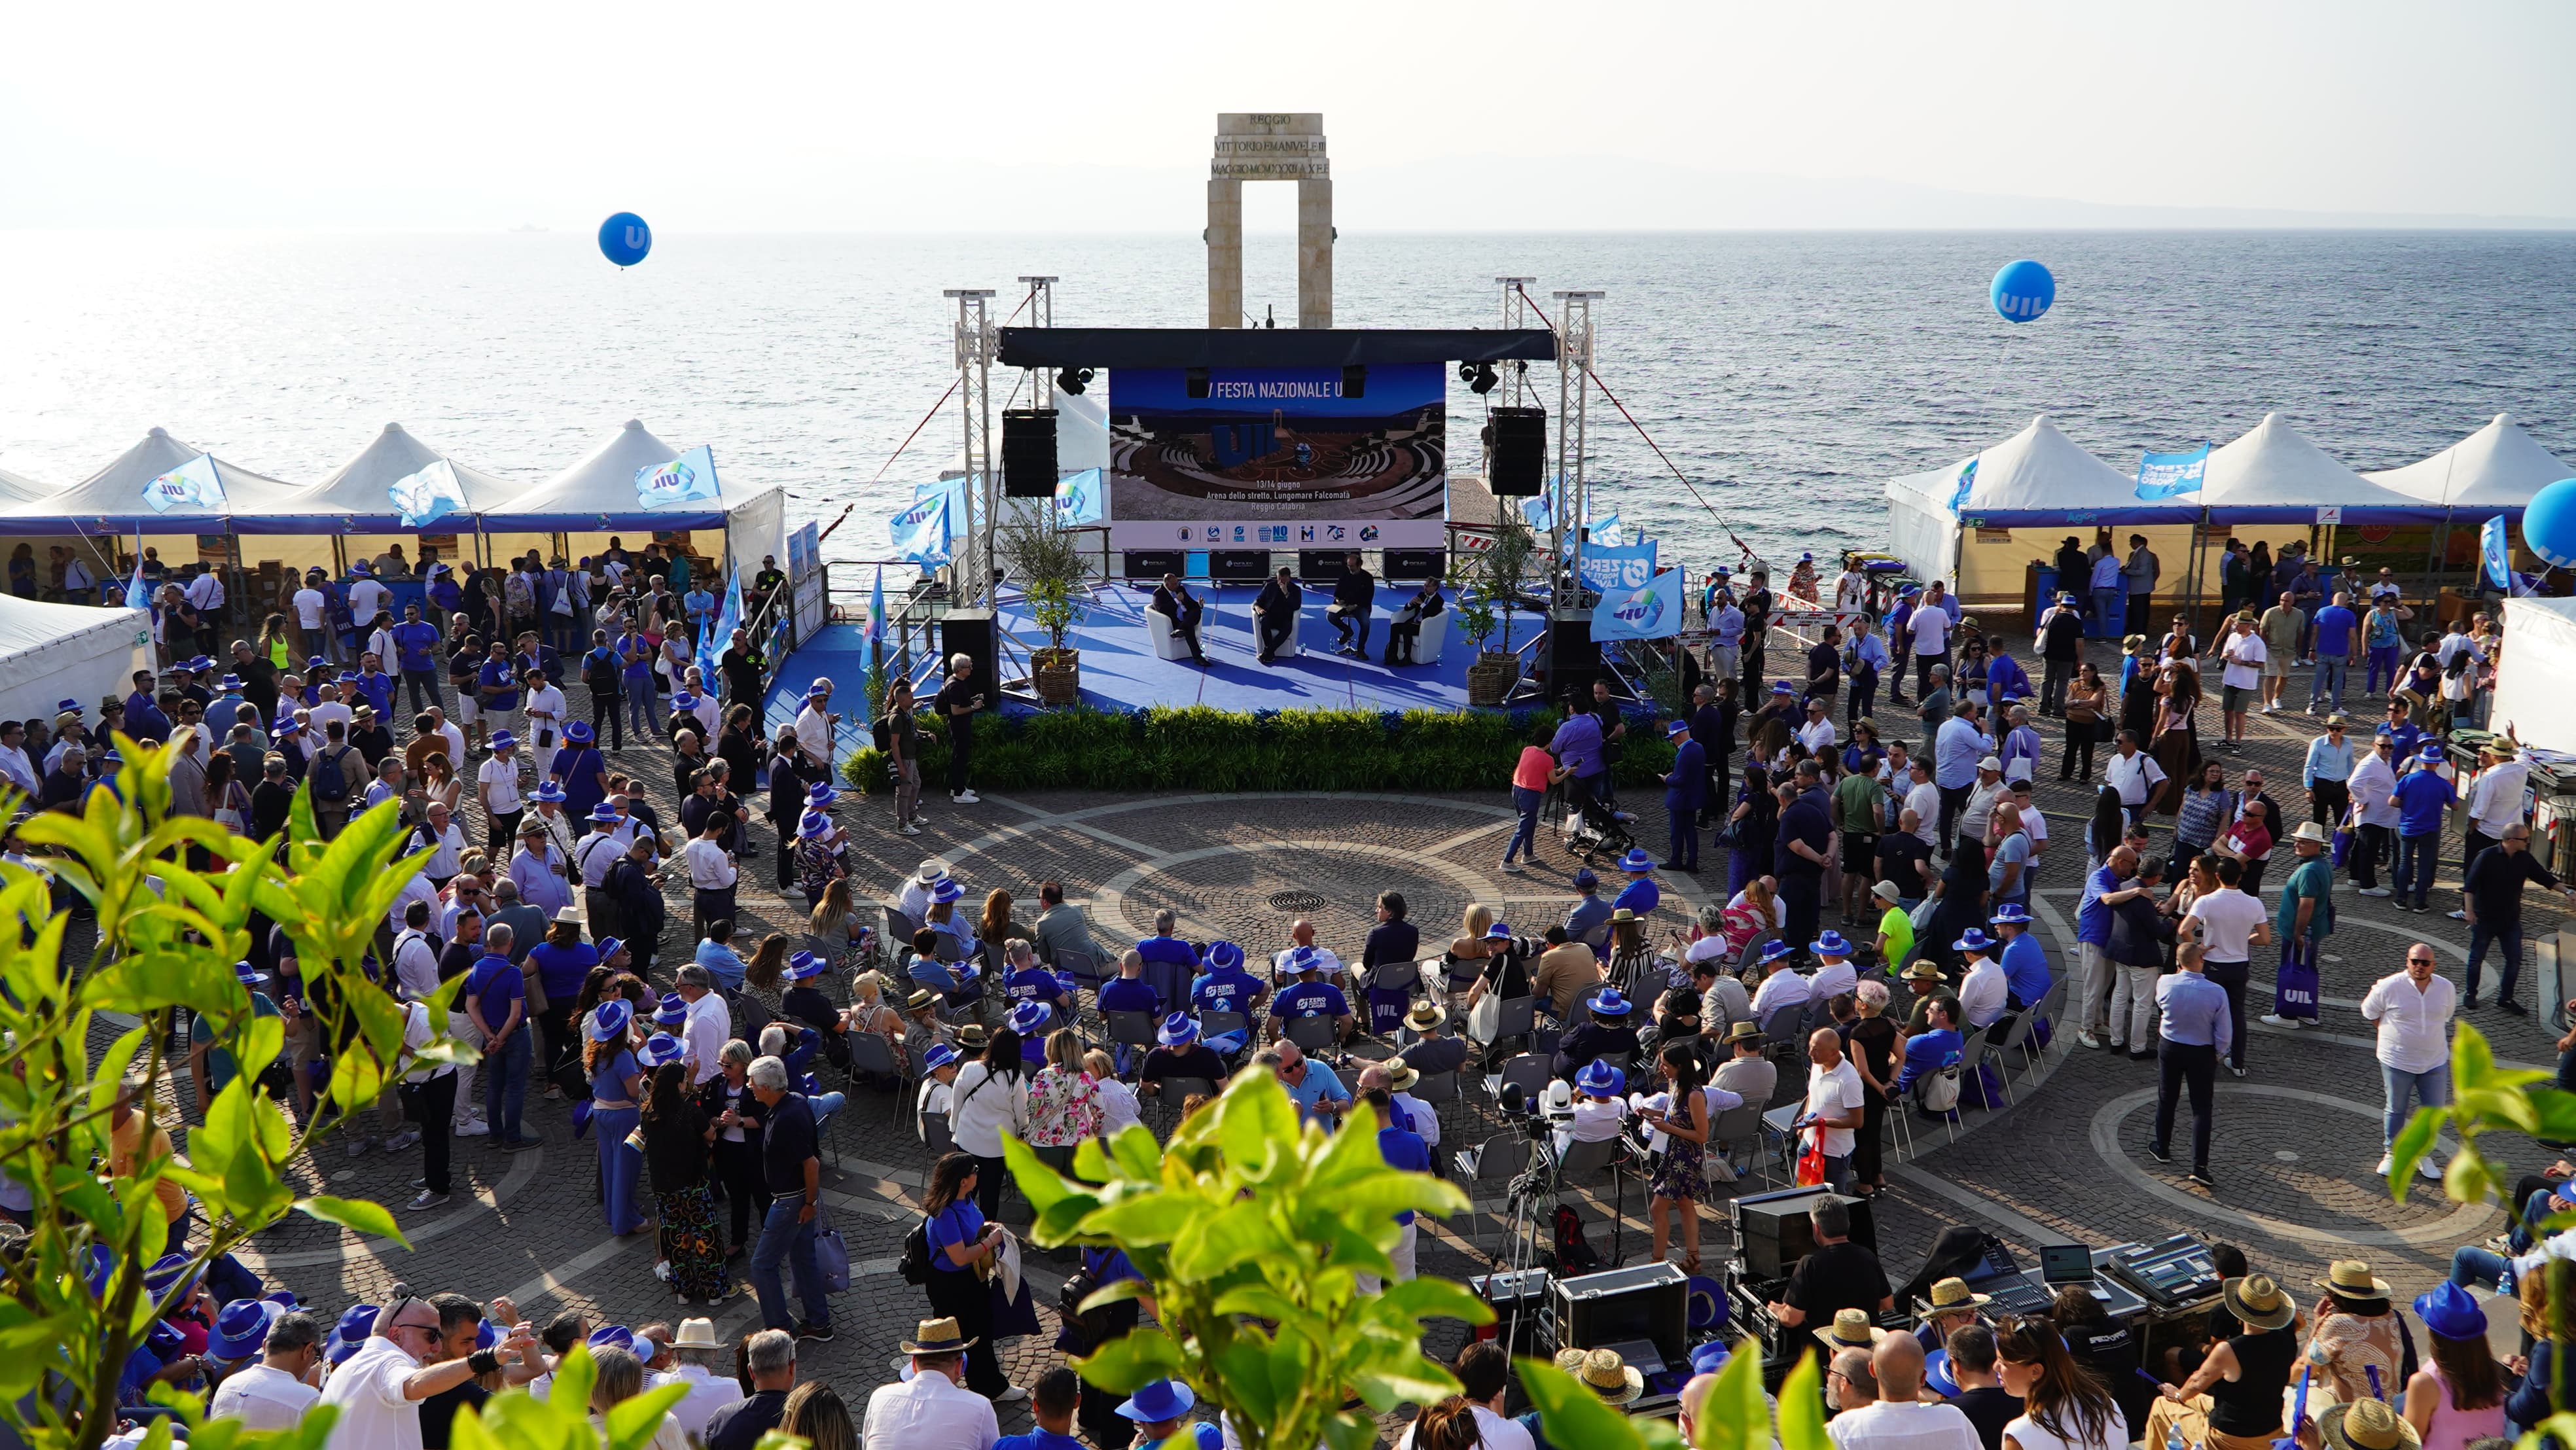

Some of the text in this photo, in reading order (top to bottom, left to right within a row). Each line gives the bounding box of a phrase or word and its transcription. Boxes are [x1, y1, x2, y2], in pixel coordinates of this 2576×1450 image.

[1250, 115, 1291, 125] REGGIO
[1215, 141, 1262, 152] VITTORIO
[1999, 292, 2046, 316] UIL
[1217, 382, 1256, 398] FESTA
[1260, 382, 1331, 398] NAZIONALE
[1213, 424, 1282, 469] UIL
[1277, 480, 1300, 489] giugno
[1206, 491, 1226, 500] Arena
[1274, 491, 1313, 502] Lungomare
[1251, 503, 1275, 512] Reggio
[1272, 525, 1288, 536] NO
[336, 621, 353, 631] UIL
[2284, 989, 2313, 1004] UIL
[1376, 1004, 1398, 1017] UIL
